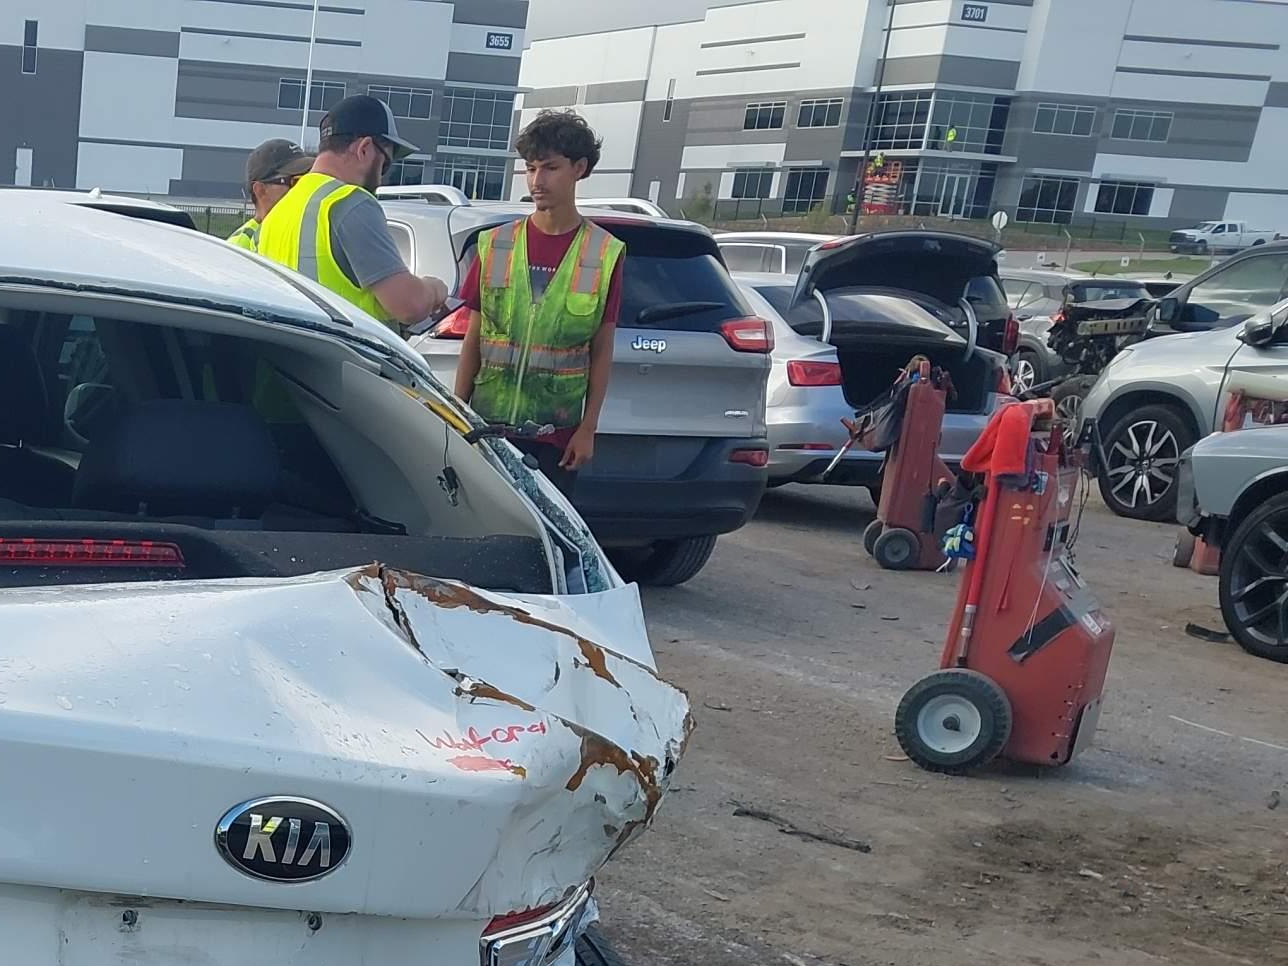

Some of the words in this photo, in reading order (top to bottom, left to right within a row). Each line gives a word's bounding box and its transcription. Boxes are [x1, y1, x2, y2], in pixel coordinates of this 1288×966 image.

[965, 7, 985, 19] 3701
[489, 35, 510, 47] 3655
[632, 336, 666, 353] Jeep
[242, 813, 331, 868] KIA
